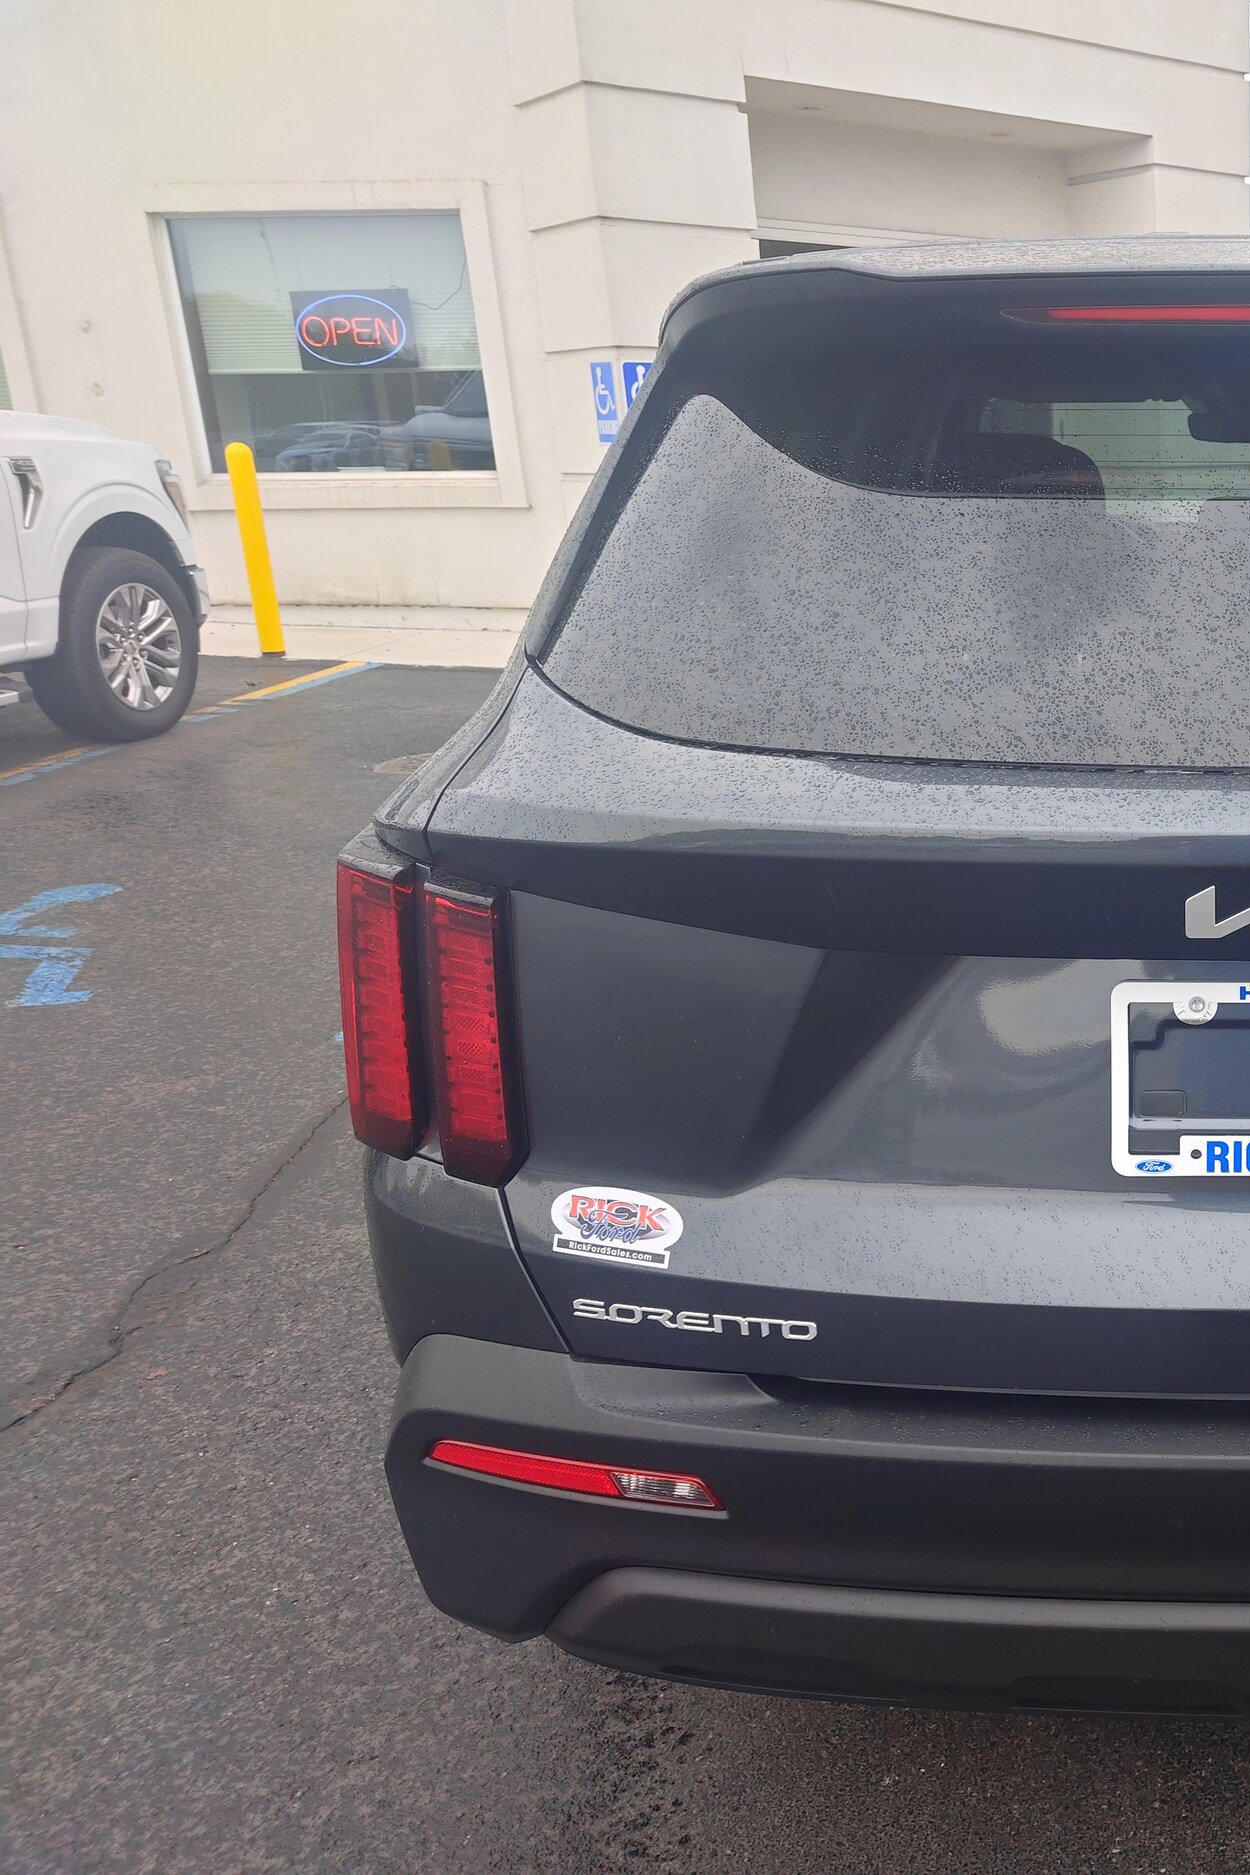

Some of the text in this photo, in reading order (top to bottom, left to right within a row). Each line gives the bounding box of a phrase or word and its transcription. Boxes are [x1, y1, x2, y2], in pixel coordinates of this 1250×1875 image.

[302, 316, 399, 347] OPEN
[569, 1194, 668, 1231] RICK
[580, 1209, 642, 1244] Ford
[568, 1241, 652, 1261] RickFordSales.com
[572, 1298, 818, 1341] SORENTO
